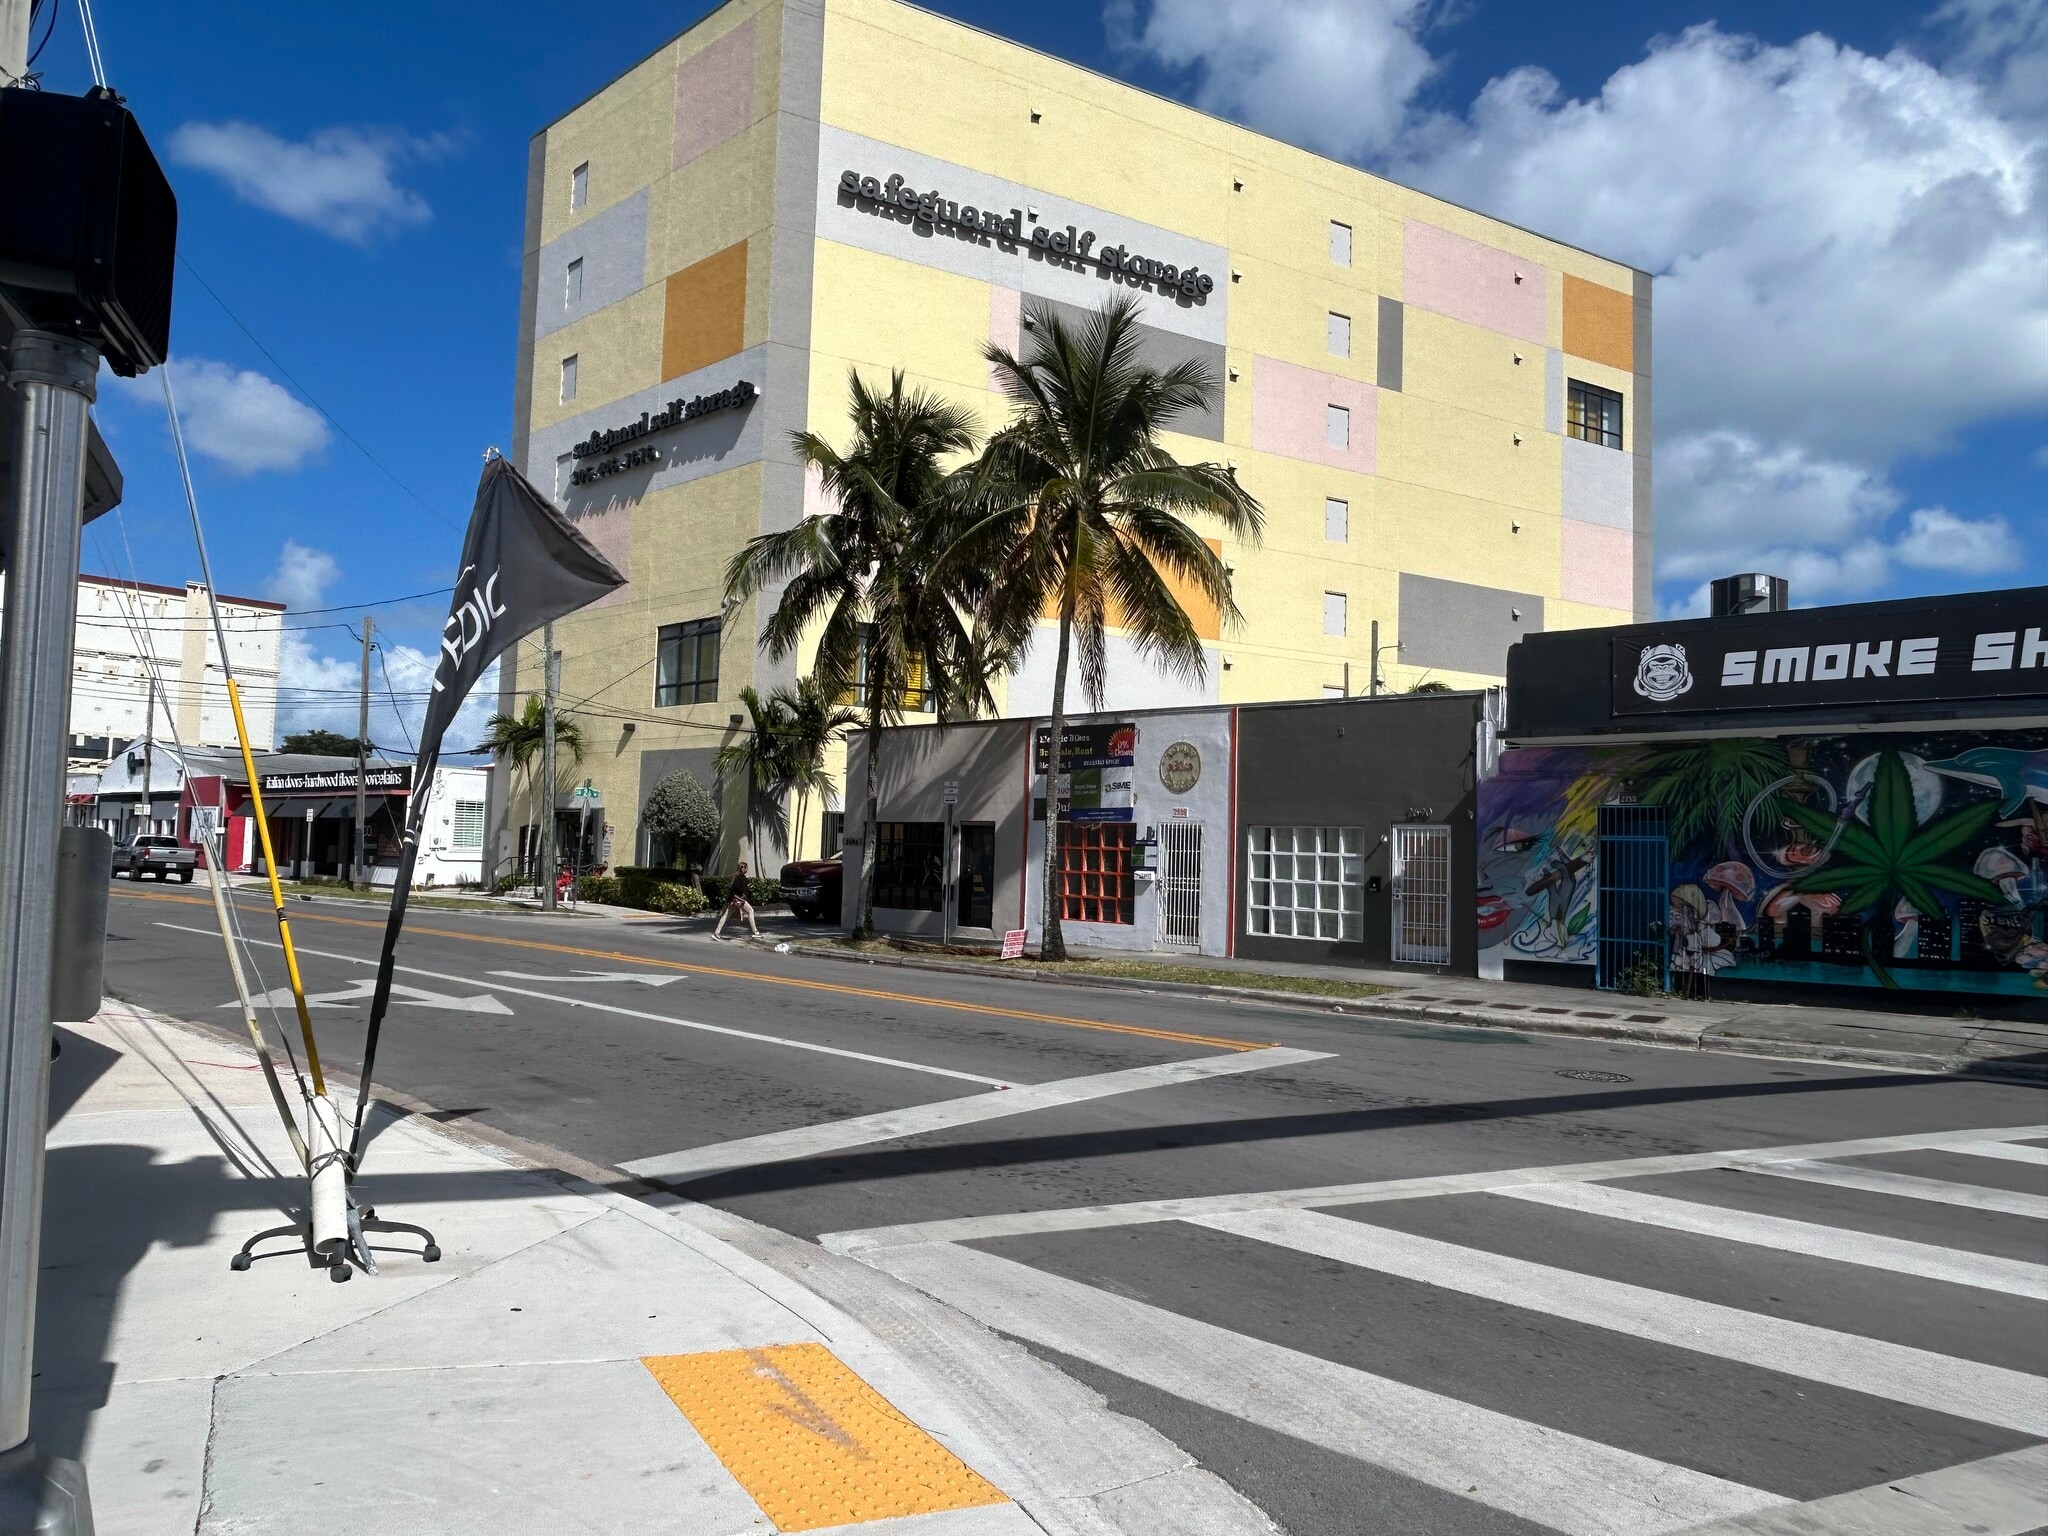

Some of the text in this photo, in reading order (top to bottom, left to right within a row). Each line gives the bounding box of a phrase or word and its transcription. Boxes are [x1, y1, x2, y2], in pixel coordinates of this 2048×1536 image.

[840, 169, 1213, 297] safeguard self storage
[573, 379, 756, 460] safeguard self storage
[433, 564, 508, 692] EDIC
[1721, 636, 1940, 687] SMOKE
